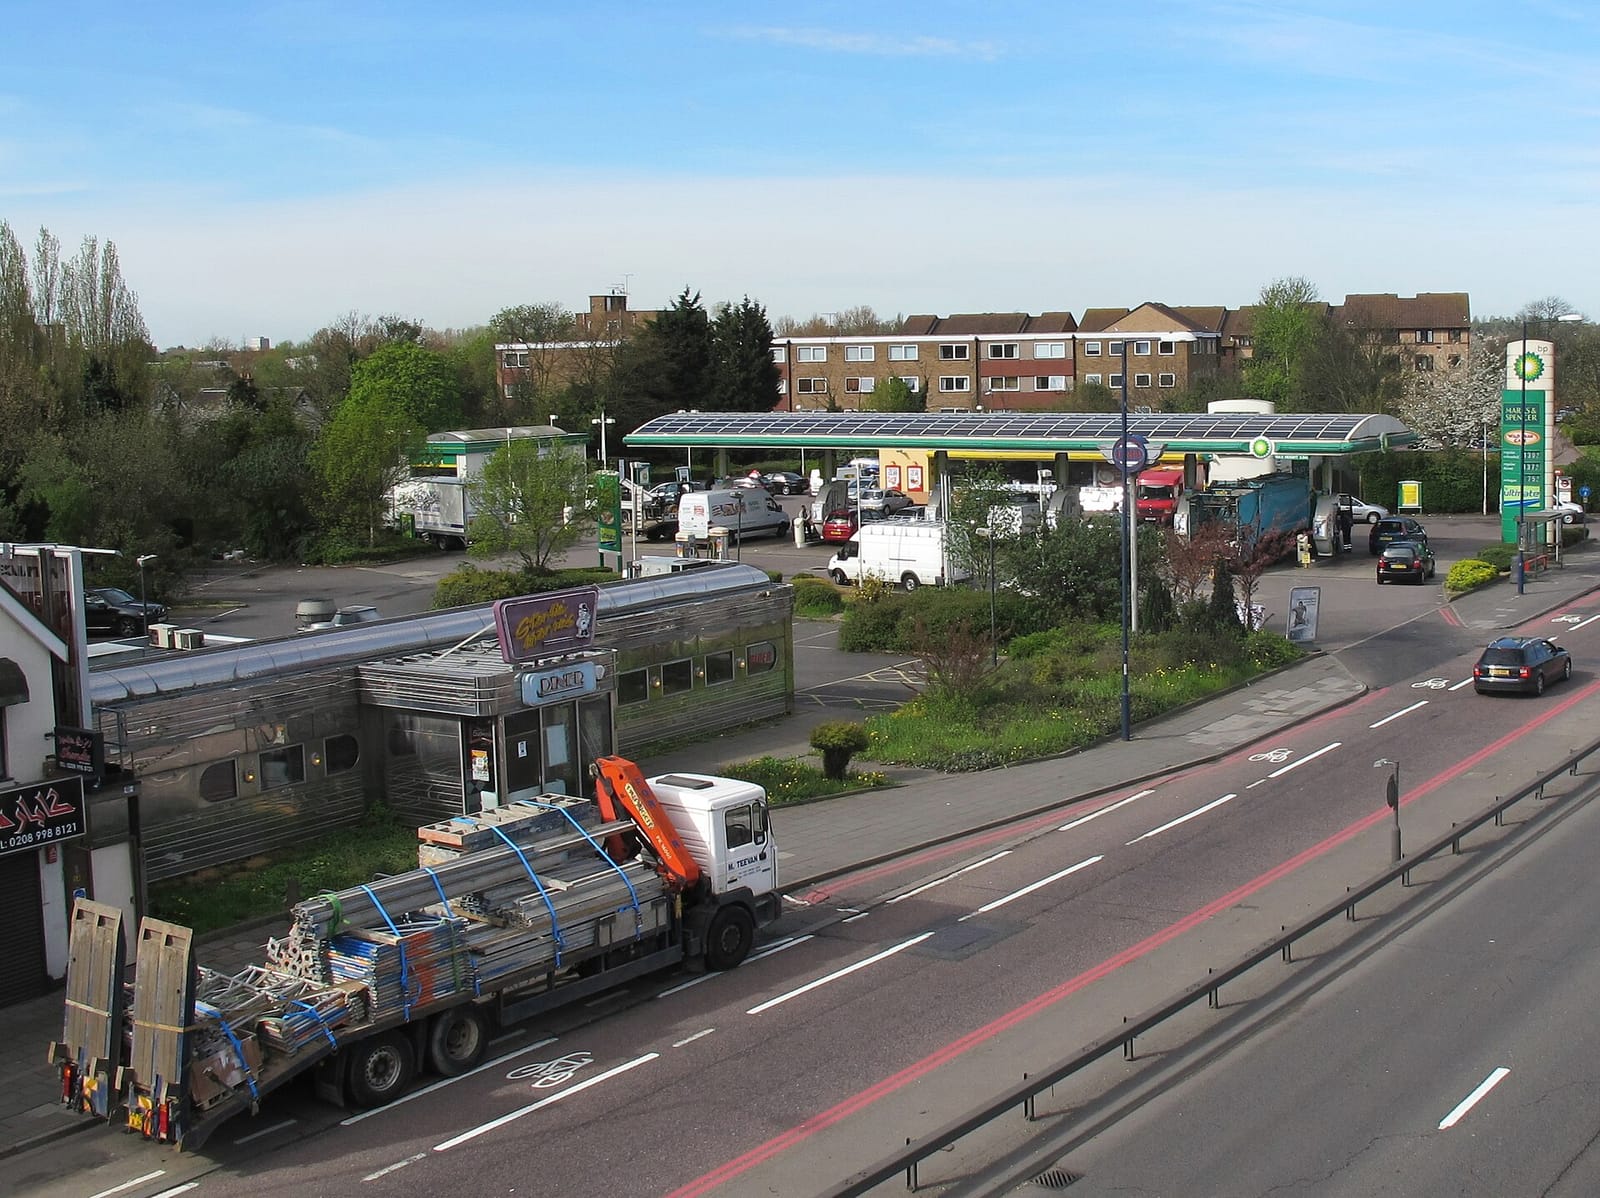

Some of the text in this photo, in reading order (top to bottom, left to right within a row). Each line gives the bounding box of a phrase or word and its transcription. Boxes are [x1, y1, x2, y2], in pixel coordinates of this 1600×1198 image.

[1537, 345, 1549, 354] bp
[538, 670, 584, 697] DINER
[9, 833, 34, 847] 0208
[35, 828, 53, 841] 998
[55, 822, 77, 836] 8121
[736, 855, 758, 868] TEEVAN
